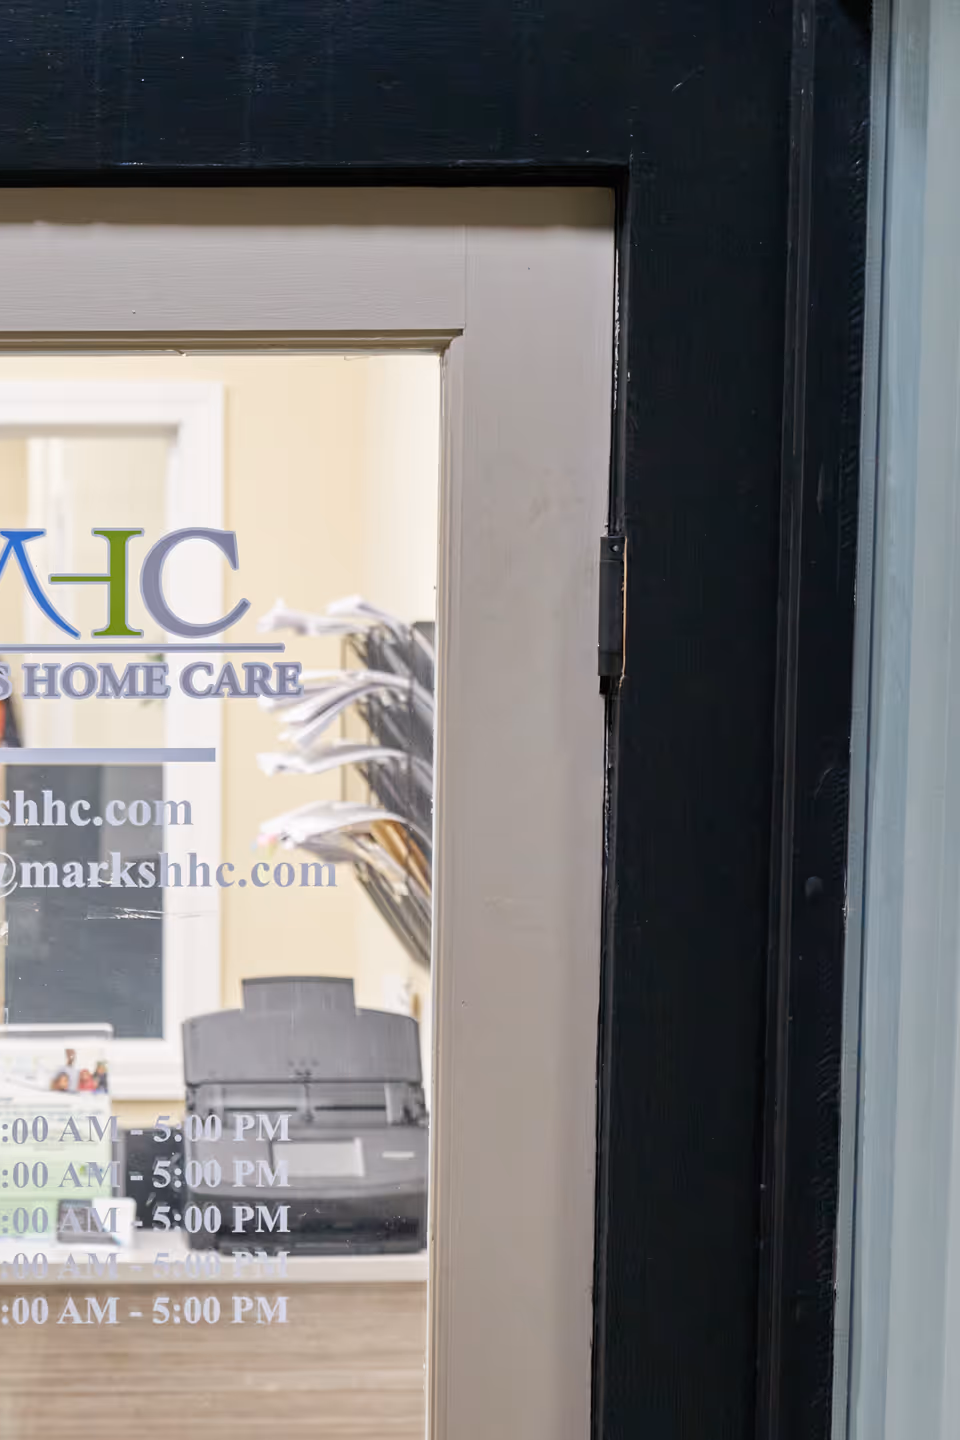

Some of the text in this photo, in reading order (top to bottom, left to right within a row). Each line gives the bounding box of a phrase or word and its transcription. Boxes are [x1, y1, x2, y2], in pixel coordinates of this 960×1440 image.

[22, 661, 171, 699] HOME
[179, 661, 304, 699] CARE
[57, 1114, 121, 1142] AM
[152, 1114, 222, 1142] 5:00
[231, 1114, 292, 1142] PM
[57, 1160, 121, 1188] AM
[152, 1160, 222, 1188] 5:00
[231, 1160, 292, 1188] PM
[57, 1206, 121, 1234] AM
[152, 1206, 222, 1234] 5:00
[231, 1206, 292, 1234] PM
[57, 1252, 121, 1280] AM
[152, 1252, 222, 1280] 5:00
[231, 1252, 292, 1280] PM
[57, 1297, 121, 1325] AM
[152, 1297, 222, 1325] 5:00
[231, 1297, 292, 1325] PM
